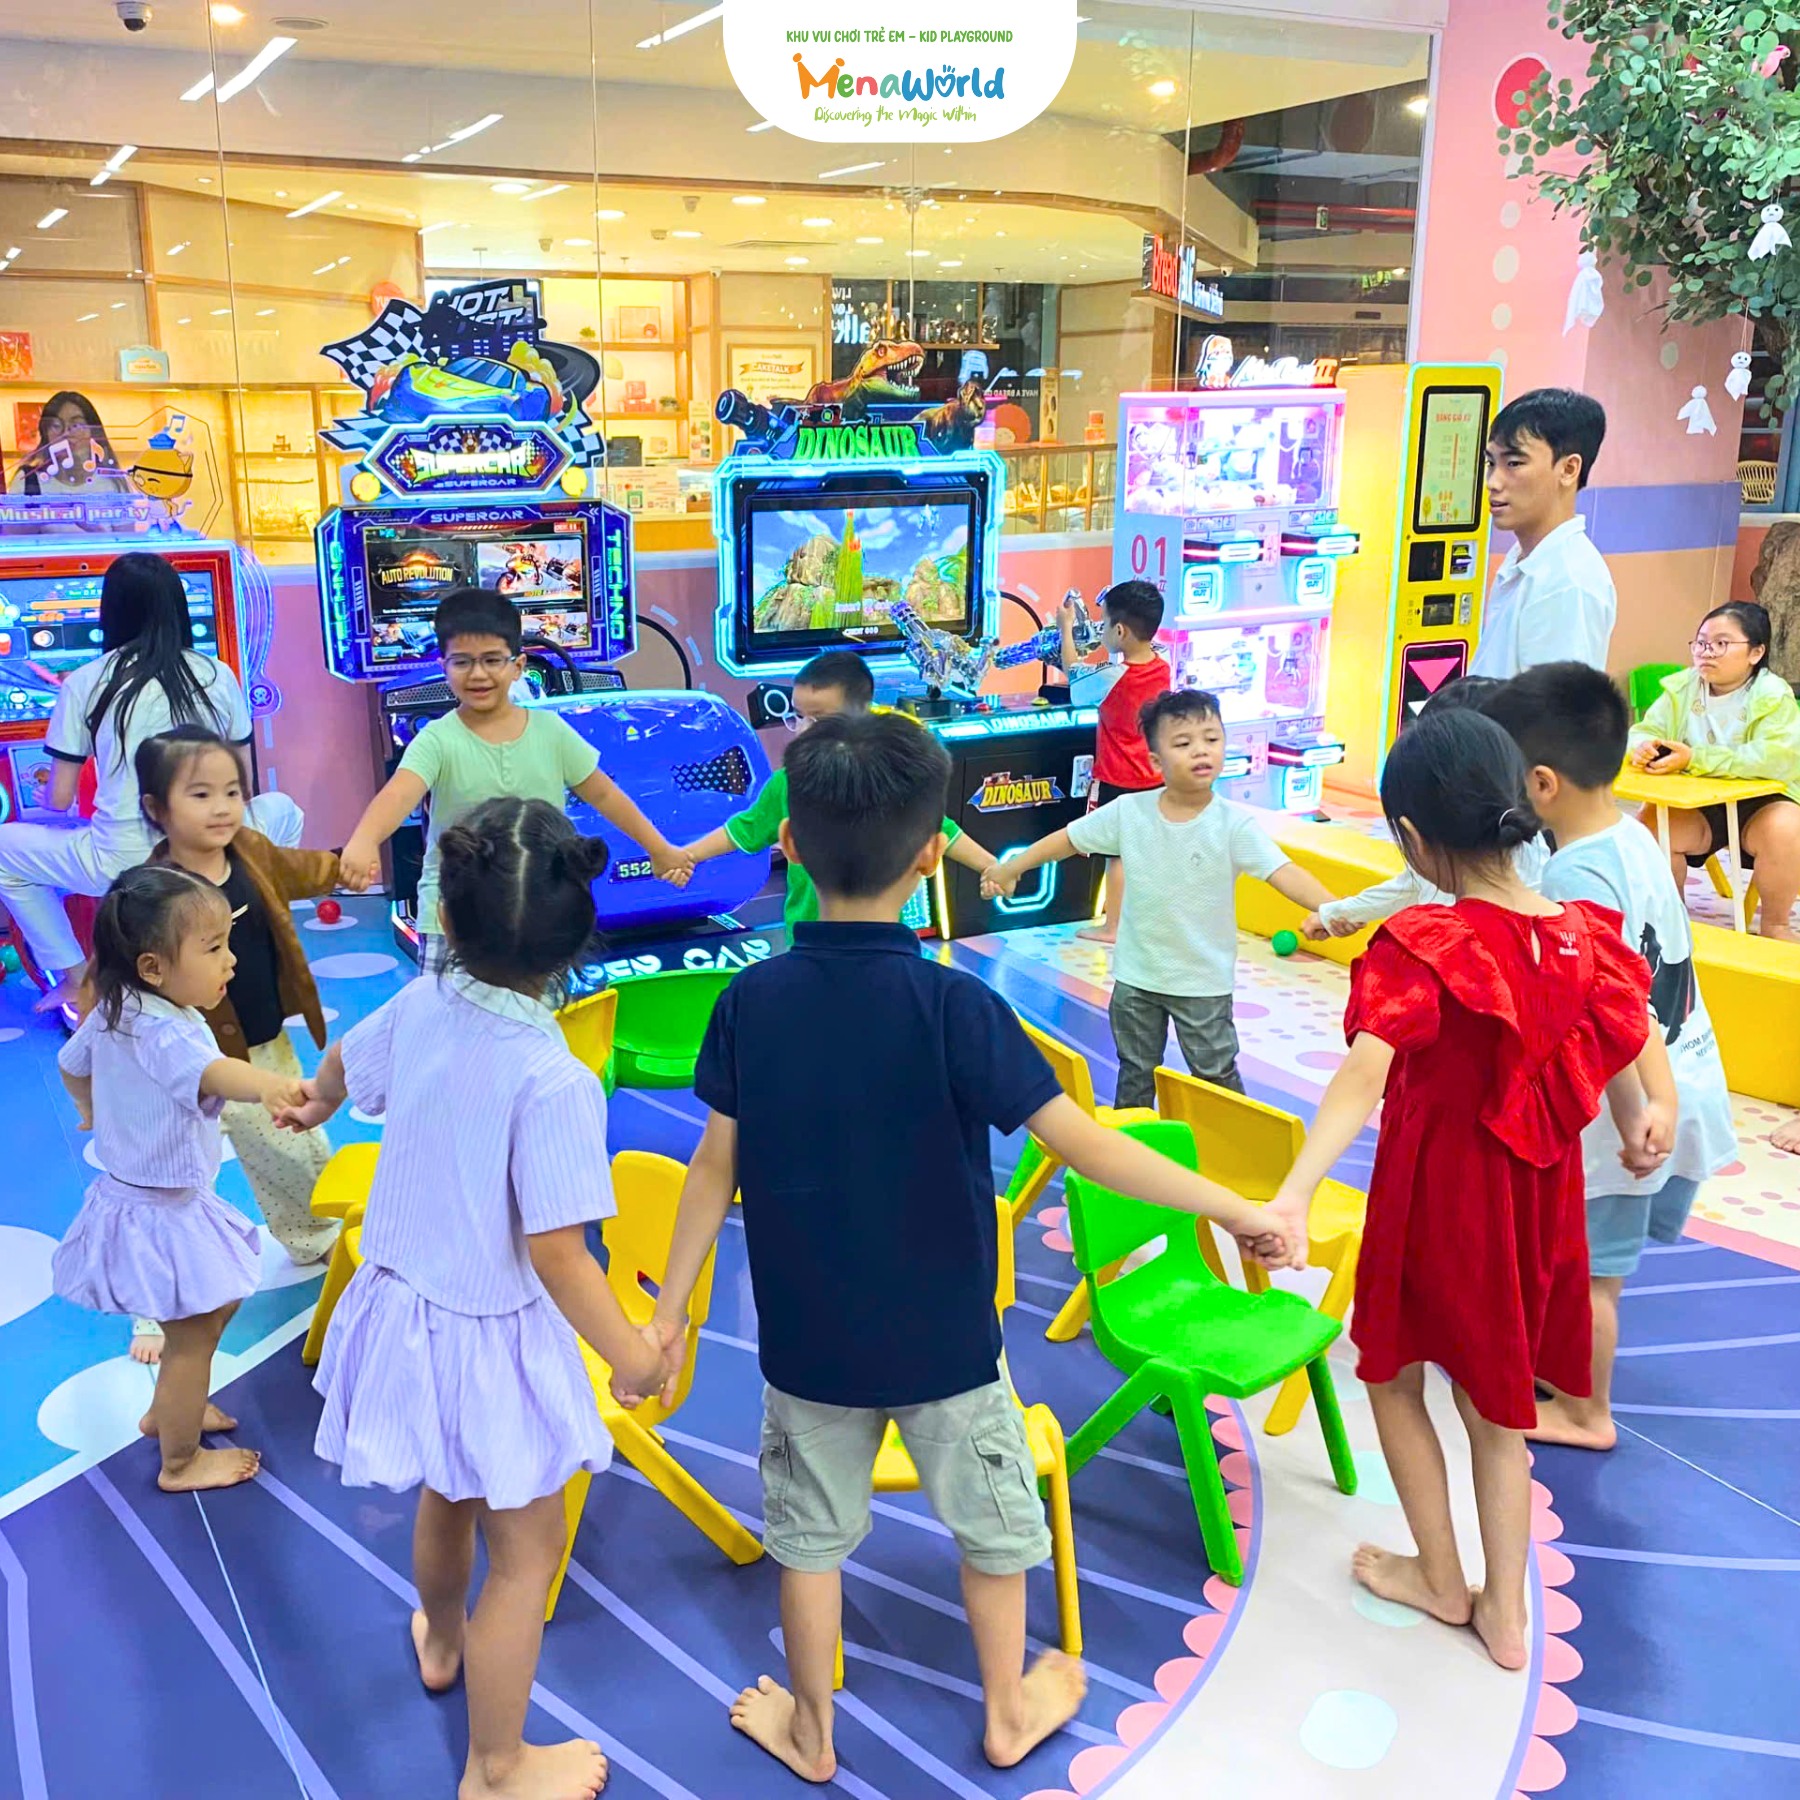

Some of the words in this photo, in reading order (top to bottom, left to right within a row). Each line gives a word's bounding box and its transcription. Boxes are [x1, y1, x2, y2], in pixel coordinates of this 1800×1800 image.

[793, 425, 921, 460] DINOSAUR
[410, 446, 532, 483] SUPERCAR
[445, 478, 517, 488] SUPERCAR
[87, 504, 150, 522] party
[430, 509, 524, 523] SUPERCAR
[1131, 534, 1167, 577] 01
[381, 569, 404, 585] AUTO
[403, 565, 454, 583] REVOLUTION
[606, 529, 626, 640] TECHNO
[990, 710, 1072, 734] DINOSAUR
[980, 779, 1053, 807] DINOSAUR
